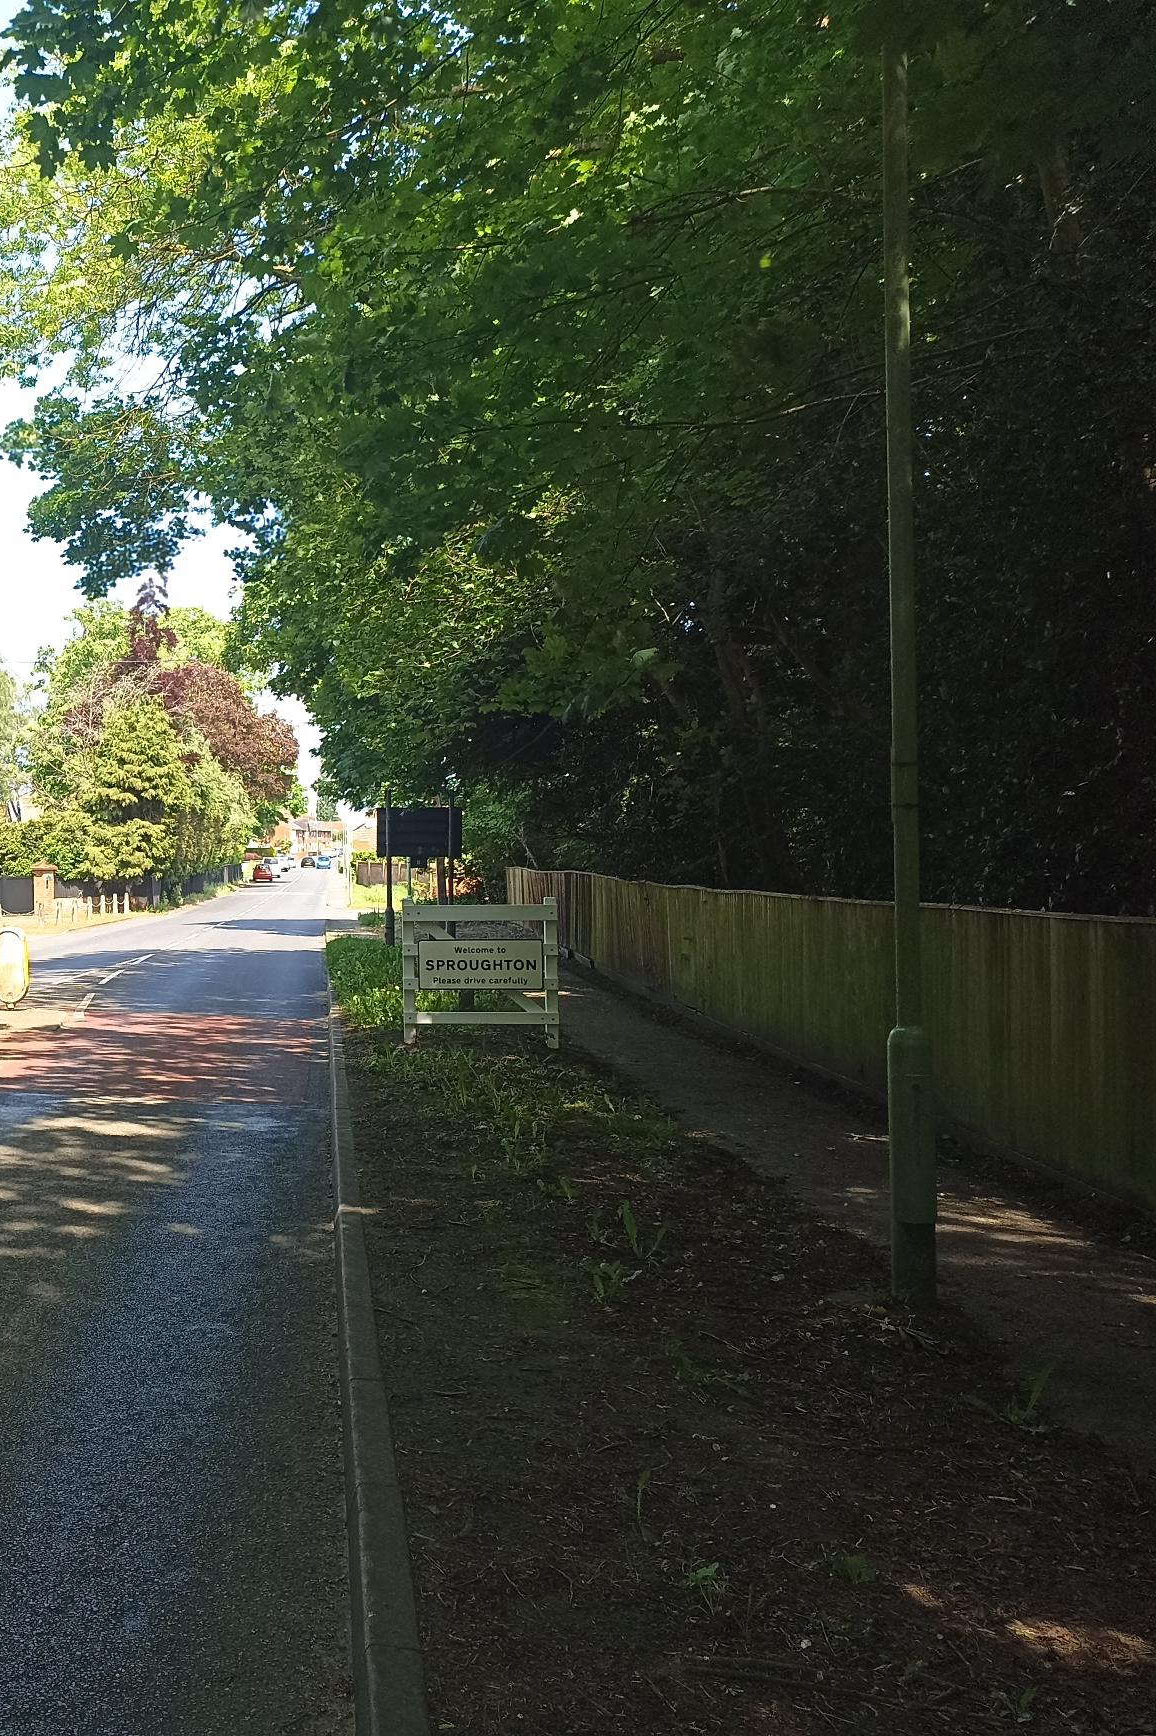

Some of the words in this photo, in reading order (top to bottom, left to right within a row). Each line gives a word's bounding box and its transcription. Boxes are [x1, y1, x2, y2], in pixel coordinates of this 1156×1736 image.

[454, 946, 494, 954] Welcome
[497, 946, 506, 954] to
[426, 959, 537, 971] SPROUGHTON
[433, 977, 461, 985] Please
[464, 977, 486, 985] drive
[489, 976, 528, 986] carefully
